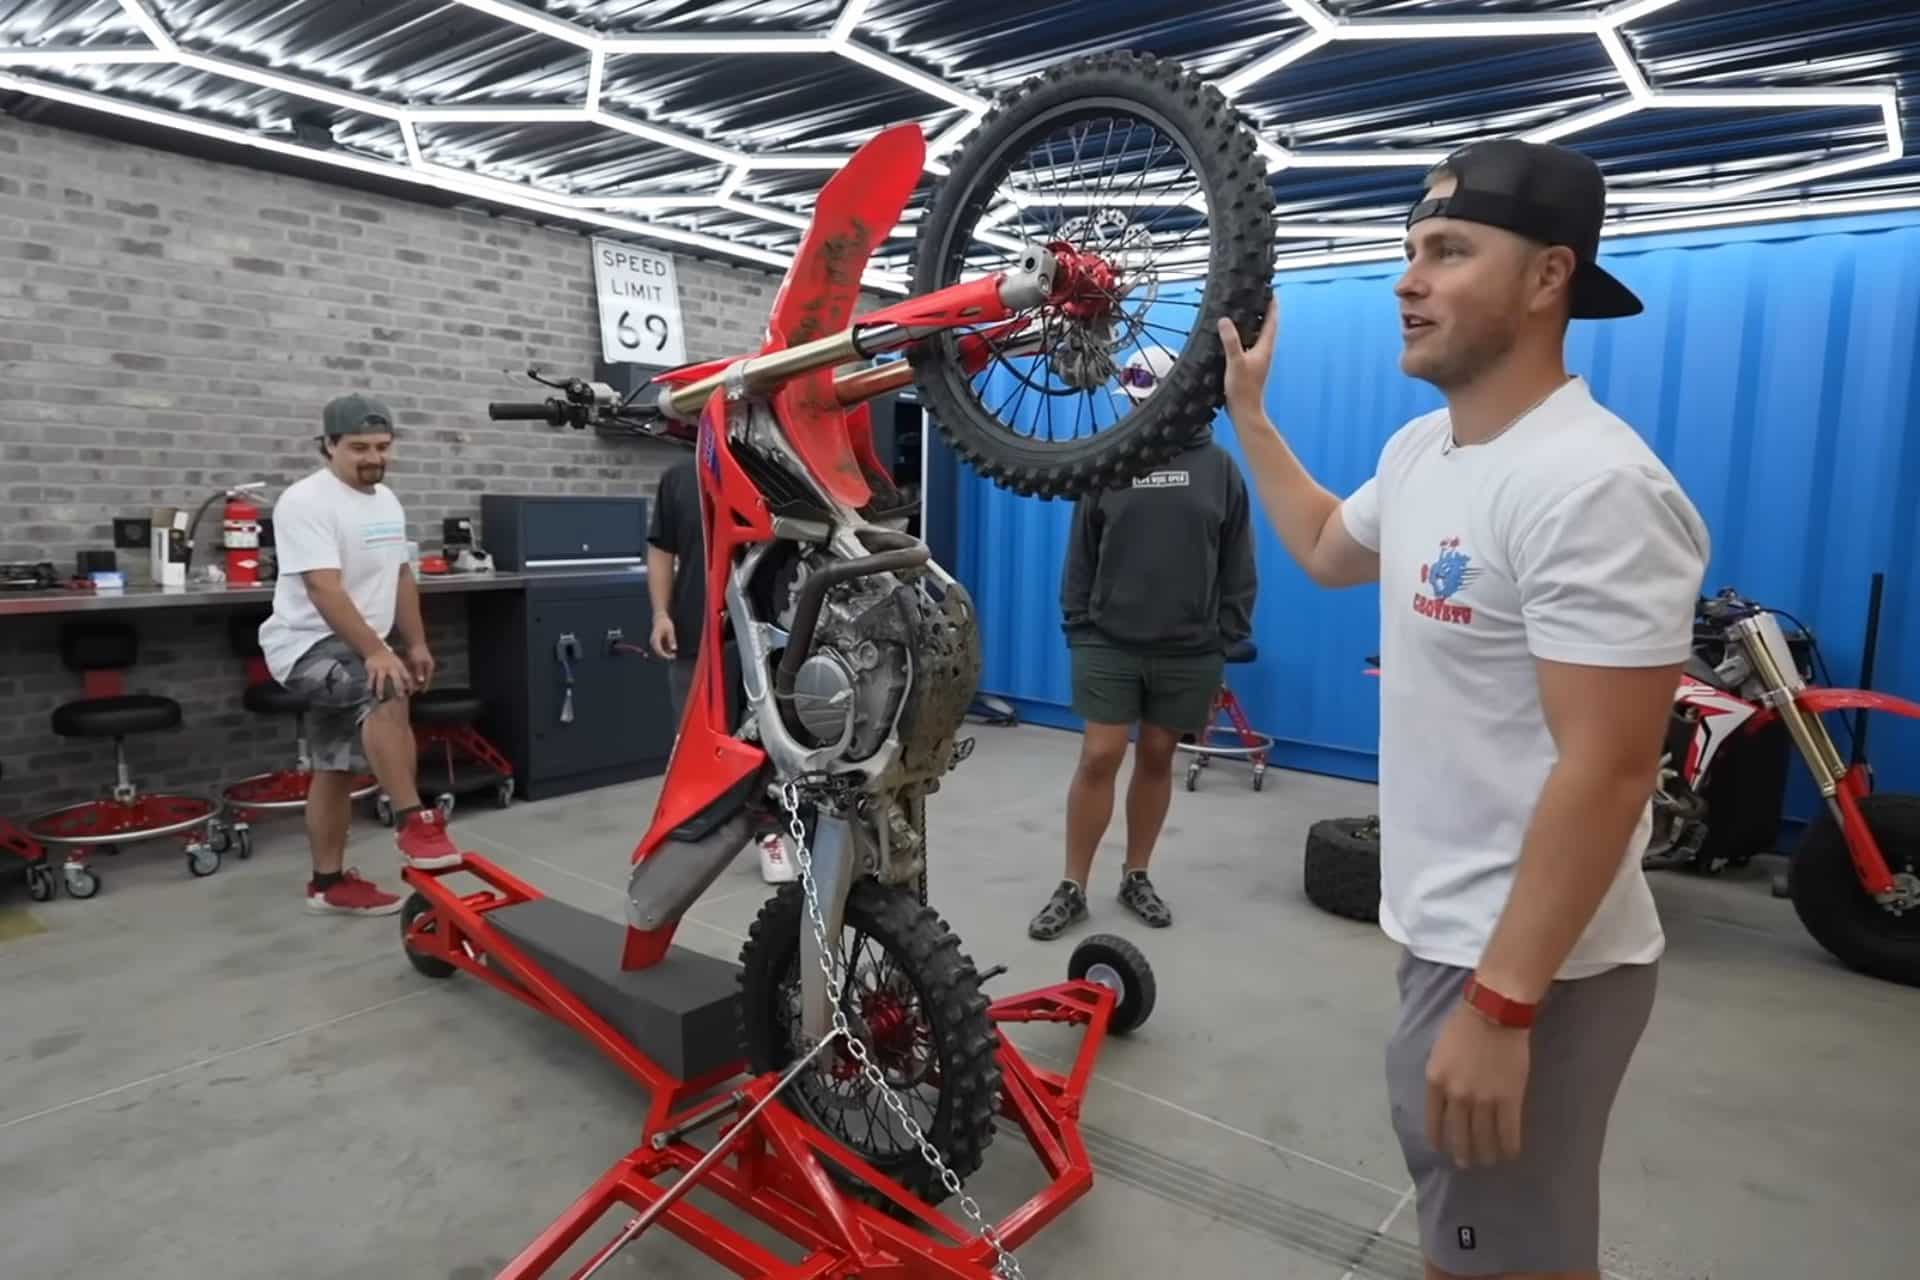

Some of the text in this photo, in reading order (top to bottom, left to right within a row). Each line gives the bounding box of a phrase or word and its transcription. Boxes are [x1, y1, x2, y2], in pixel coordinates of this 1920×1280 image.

[602, 249, 667, 277] SPEED
[611, 279, 662, 302] LIMIT
[617, 309, 668, 352] 69
